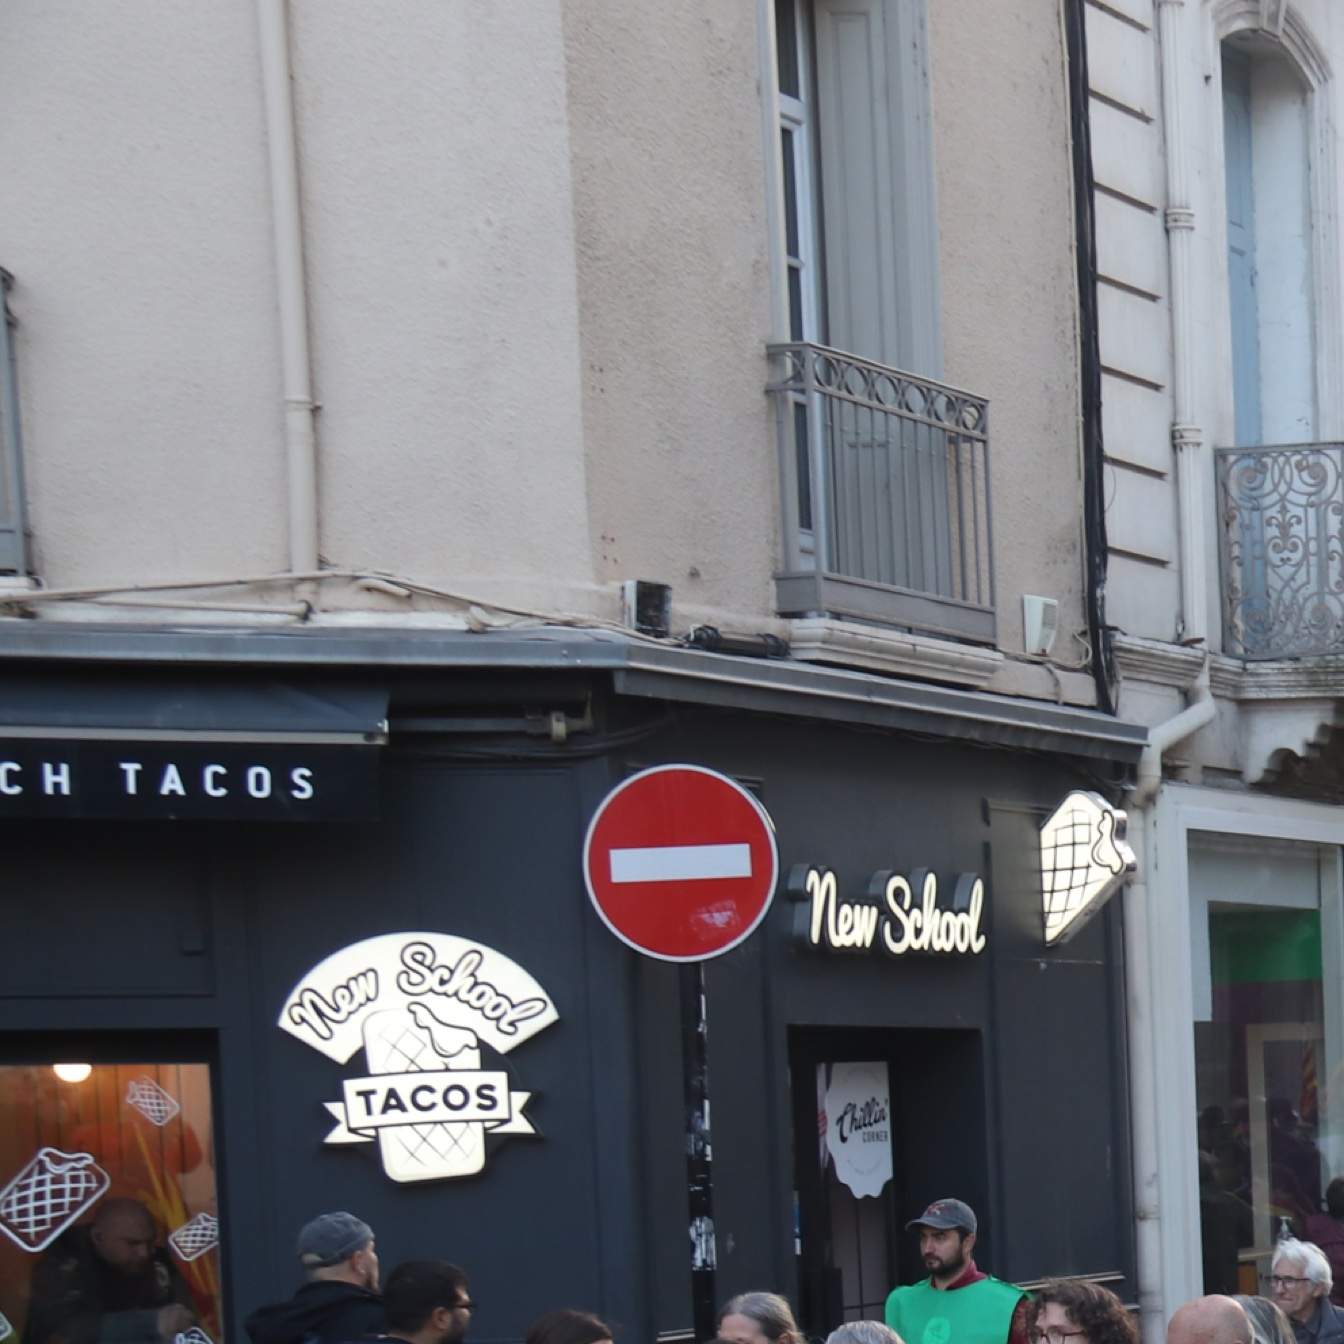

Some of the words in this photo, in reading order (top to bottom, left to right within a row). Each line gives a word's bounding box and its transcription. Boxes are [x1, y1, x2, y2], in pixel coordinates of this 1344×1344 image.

[0, 762, 71, 796] CH
[119, 763, 314, 800] TACOS
[805, 868, 879, 949] New
[884, 871, 987, 956] School
[289, 967, 379, 1041] New
[396, 940, 548, 1037] School
[355, 1083, 499, 1118] TACOS
